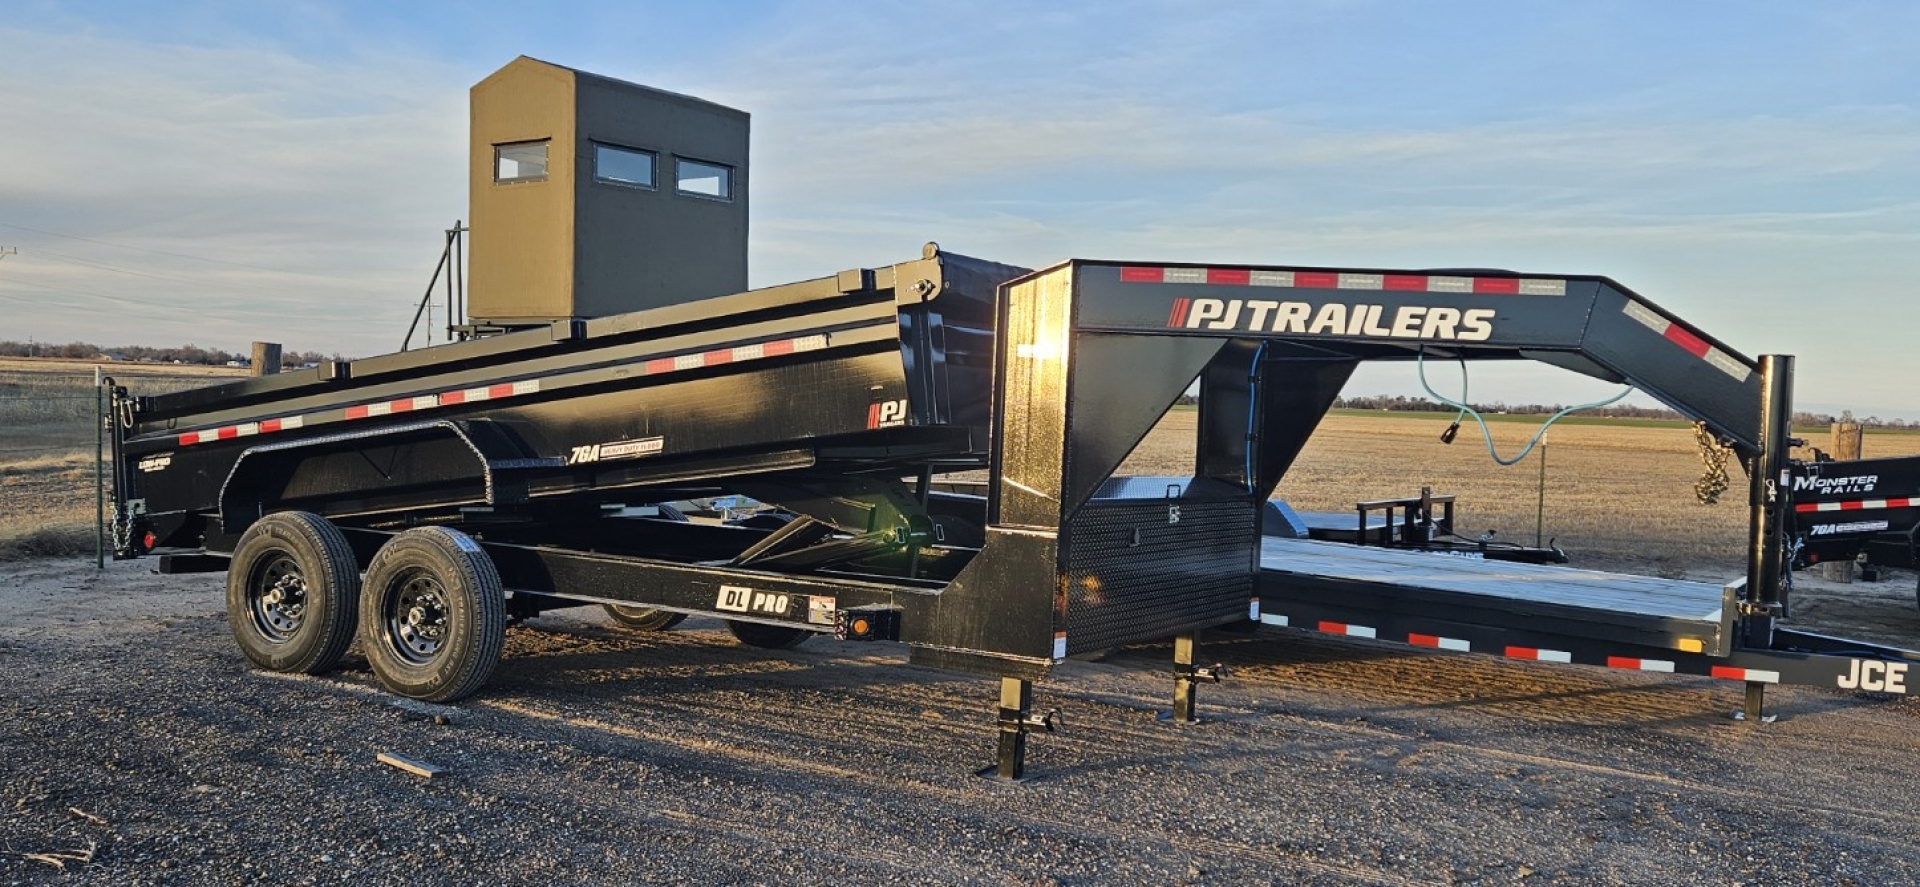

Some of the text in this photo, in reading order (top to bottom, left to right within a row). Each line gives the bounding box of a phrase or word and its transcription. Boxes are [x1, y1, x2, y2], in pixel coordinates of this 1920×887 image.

[1186, 298, 1496, 341] PJ TRAILERS
[880, 399, 907, 422] PJ
[570, 444, 600, 464] 7GA
[1794, 475, 1878, 491] MONSTER
[1821, 484, 1874, 494] RAILS
[725, 590, 744, 608] DL
[752, 592, 788, 613] PRO
[1837, 658, 1908, 694] JCE
